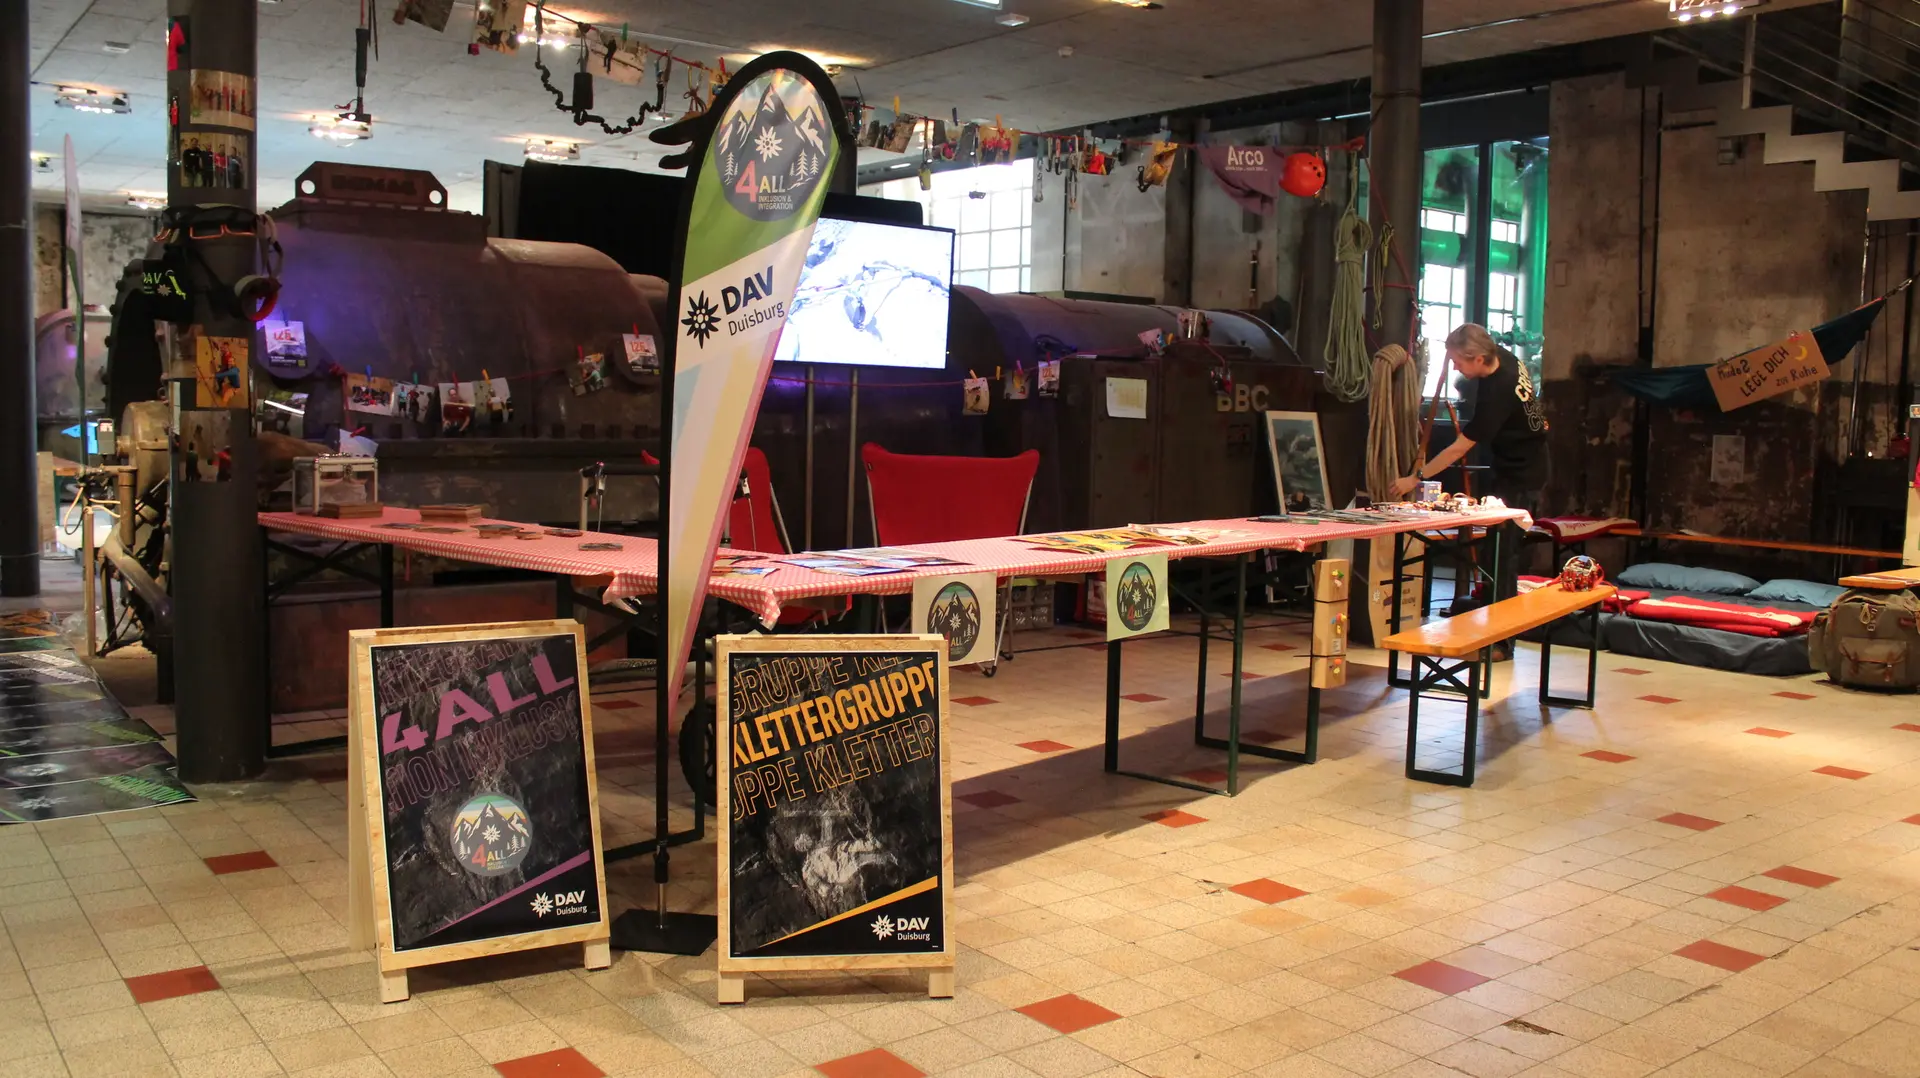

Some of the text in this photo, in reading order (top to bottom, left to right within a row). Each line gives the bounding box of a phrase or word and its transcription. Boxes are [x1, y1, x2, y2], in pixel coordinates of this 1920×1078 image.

[1227, 145, 1264, 166] Arco
[758, 195, 786, 203] INKLUSION
[758, 202, 794, 210] INTEGRATION
[721, 265, 773, 315] DAV
[728, 301, 785, 336] Duisburg
[1740, 346, 1790, 398] LEGE DICH
[1789, 365, 1818, 382] Ruhe
[1217, 384, 1270, 412] BBC
[382, 653, 574, 755] 4ALL
[471, 844, 506, 868] 4ALL
[555, 890, 585, 906] DAV
[556, 904, 588, 916] Duisburg
[897, 917, 930, 931] DAV
[897, 932, 931, 941] Duisburg
